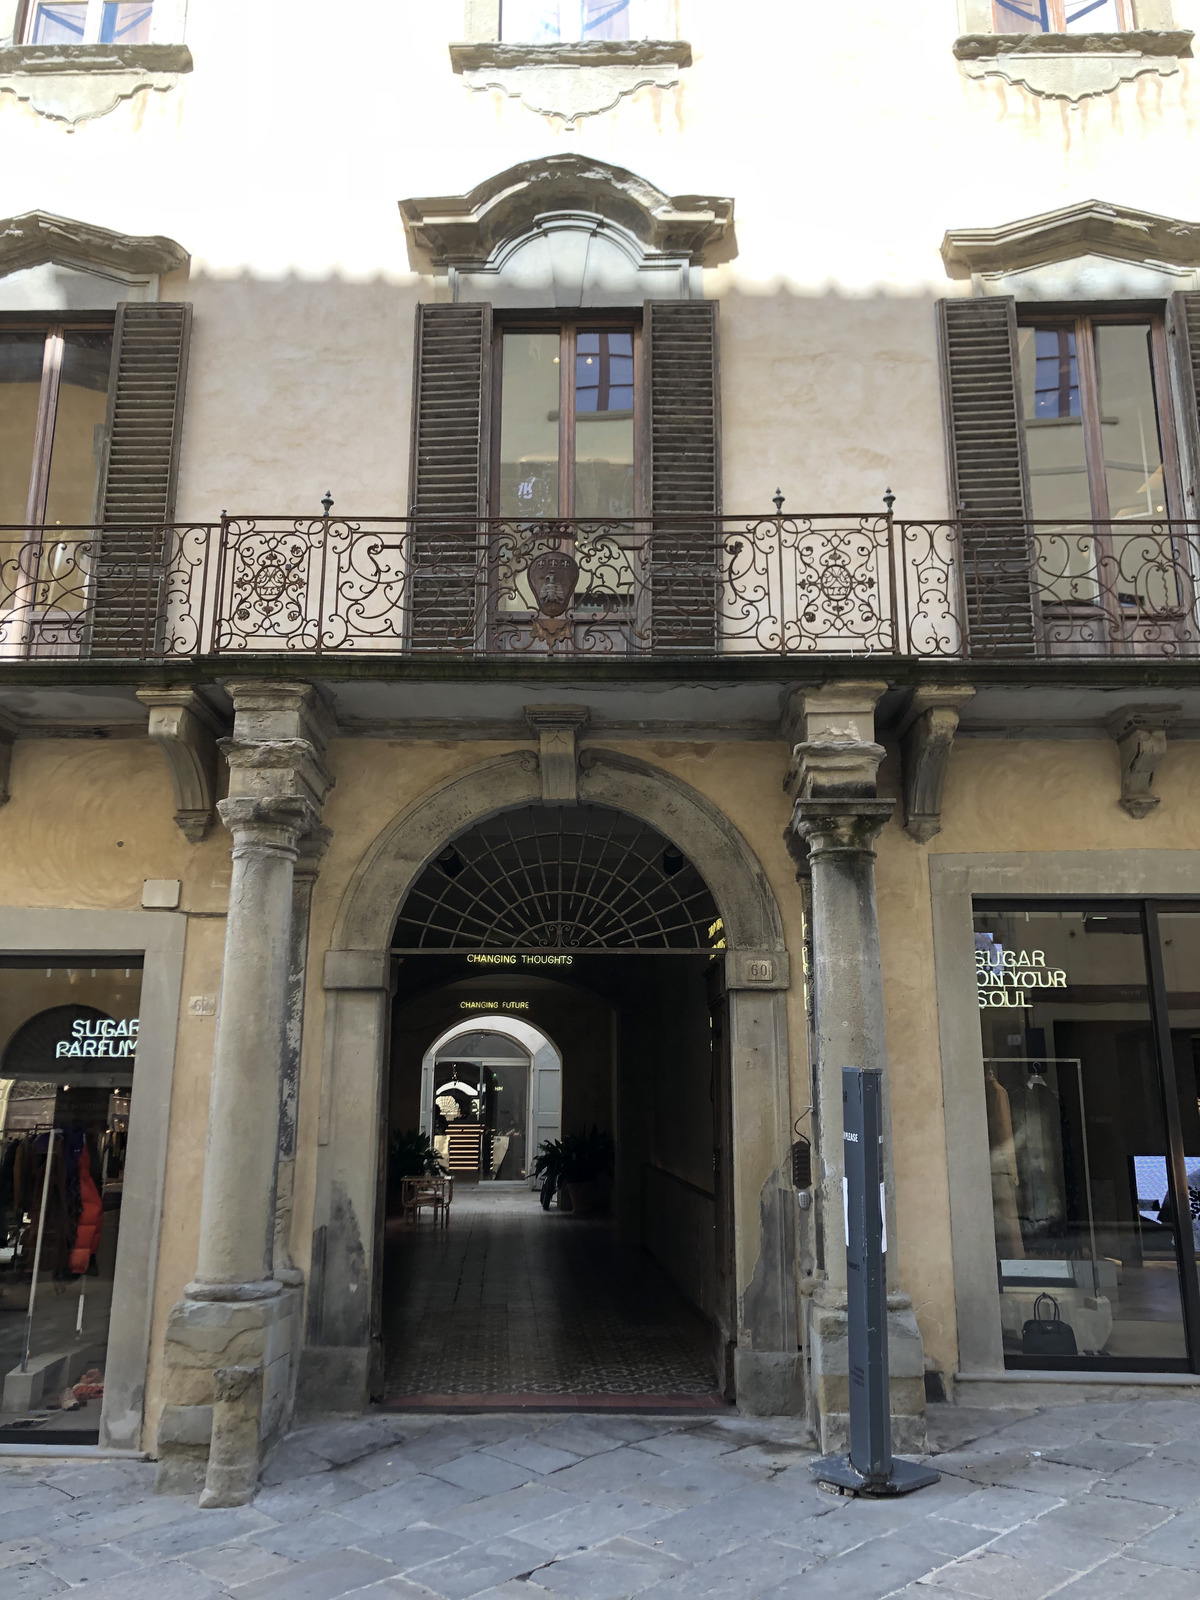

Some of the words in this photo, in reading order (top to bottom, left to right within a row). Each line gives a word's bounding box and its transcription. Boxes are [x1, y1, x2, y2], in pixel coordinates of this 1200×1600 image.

[466, 954, 516, 964] CHANGING
[521, 955, 573, 965] THOUGHTS
[974, 950, 1045, 968] SUGAR
[751, 964, 767, 976] 60
[976, 969, 1004, 988] ON
[1008, 970, 1067, 988] YOUR
[460, 1001, 499, 1009] CHANGING
[977, 990, 1033, 1009] SOUL
